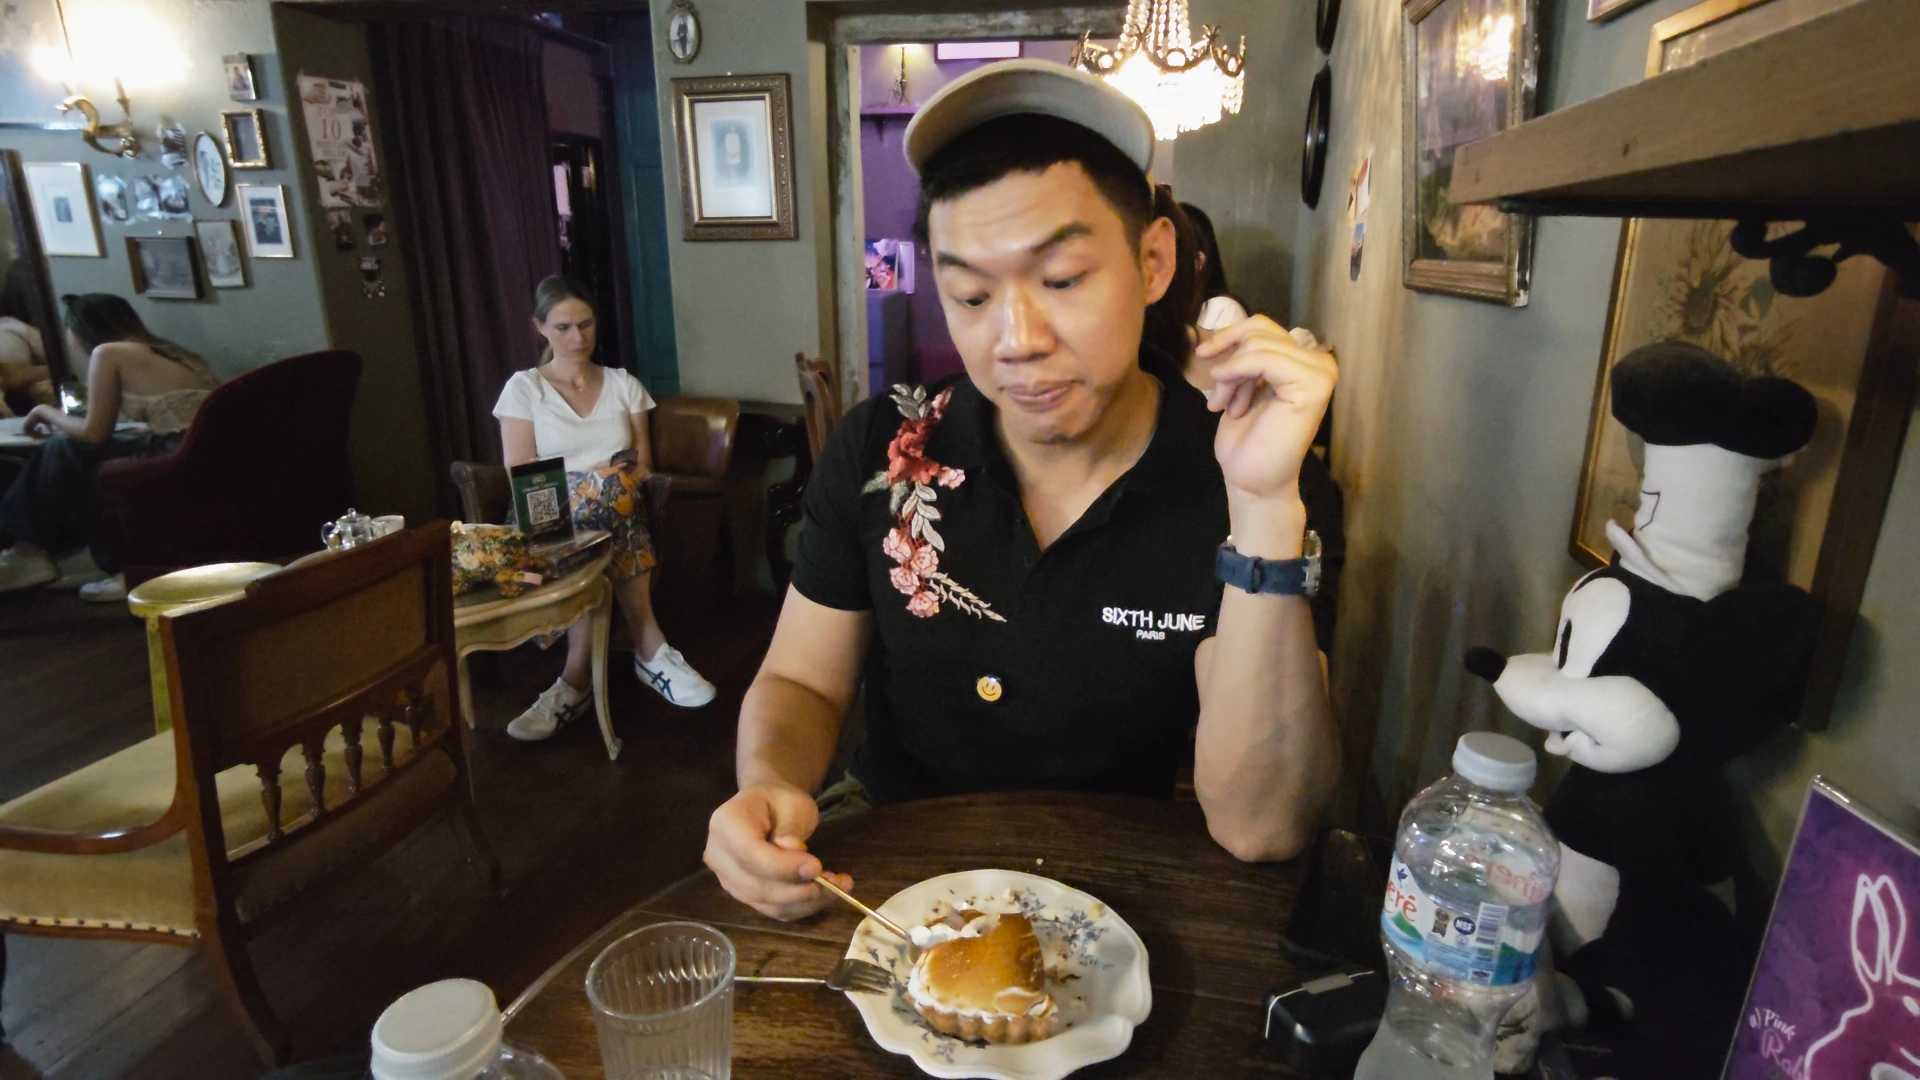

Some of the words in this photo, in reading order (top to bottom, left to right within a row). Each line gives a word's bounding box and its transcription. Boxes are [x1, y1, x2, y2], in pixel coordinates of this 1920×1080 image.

[321, 118, 342, 140] 10
[1102, 606, 1153, 628] SIXTH
[1157, 612, 1205, 632] JUNE
[1136, 629, 1165, 640] PARIS
[1455, 918, 1474, 933] NSF
[1763, 1007, 1796, 1041] Pink
